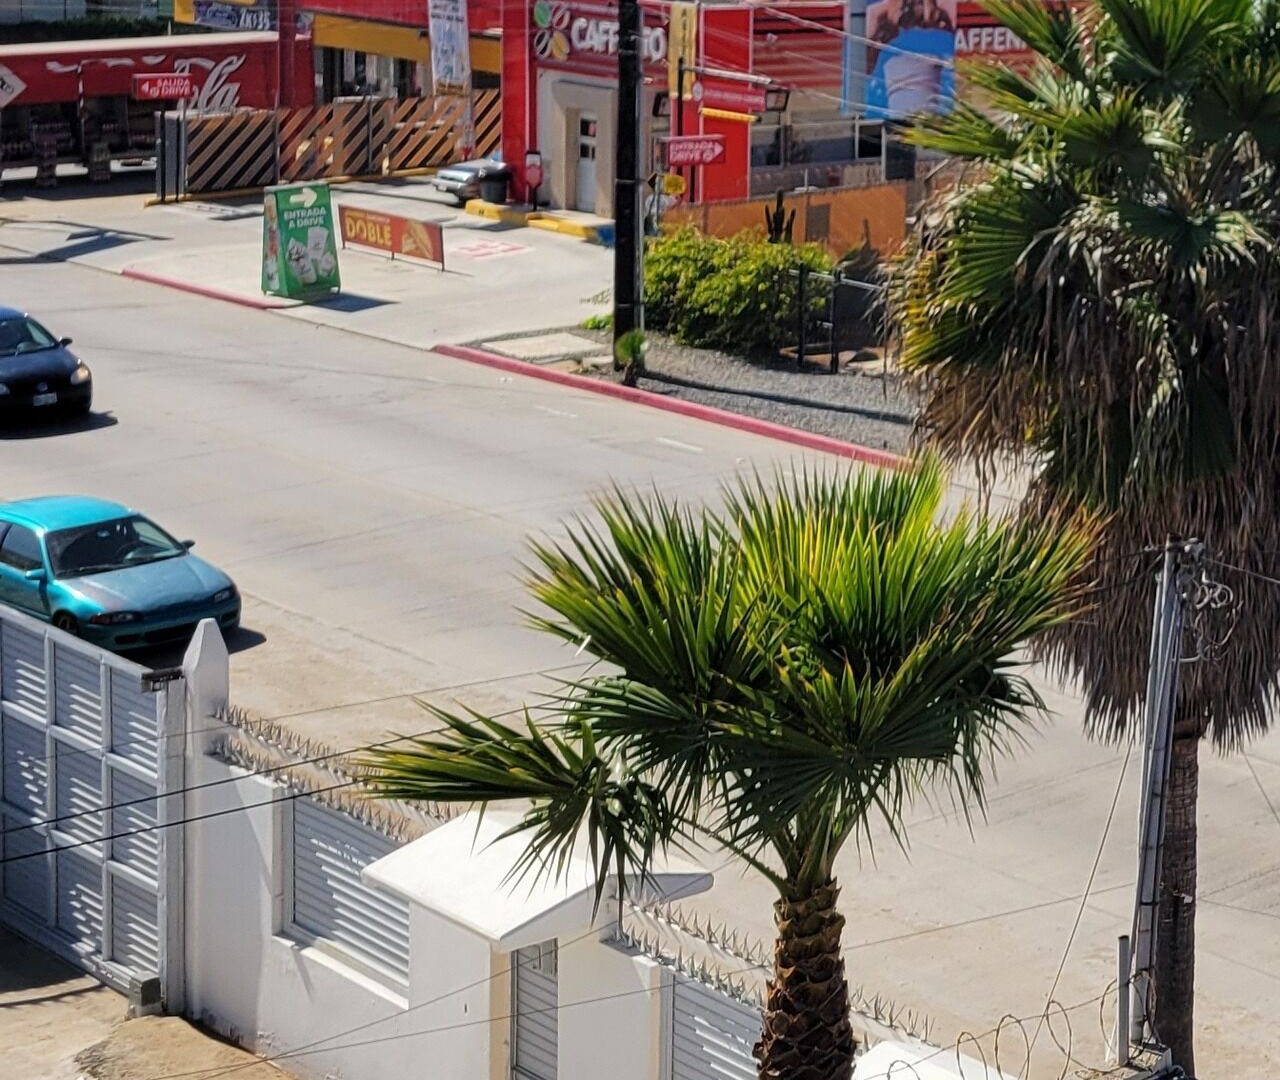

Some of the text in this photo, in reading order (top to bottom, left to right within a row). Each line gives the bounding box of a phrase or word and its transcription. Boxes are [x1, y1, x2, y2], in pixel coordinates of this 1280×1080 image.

[570, 17, 667, 64] CAFFIO
[156, 77, 191, 89] SALIDA
[160, 86, 191, 97] DRIVE
[669, 149, 701, 162] DRIVE
[283, 206, 327, 221] ENTRADA
[288, 216, 325, 230] A DRIVE
[345, 218, 393, 247] DOBLE
